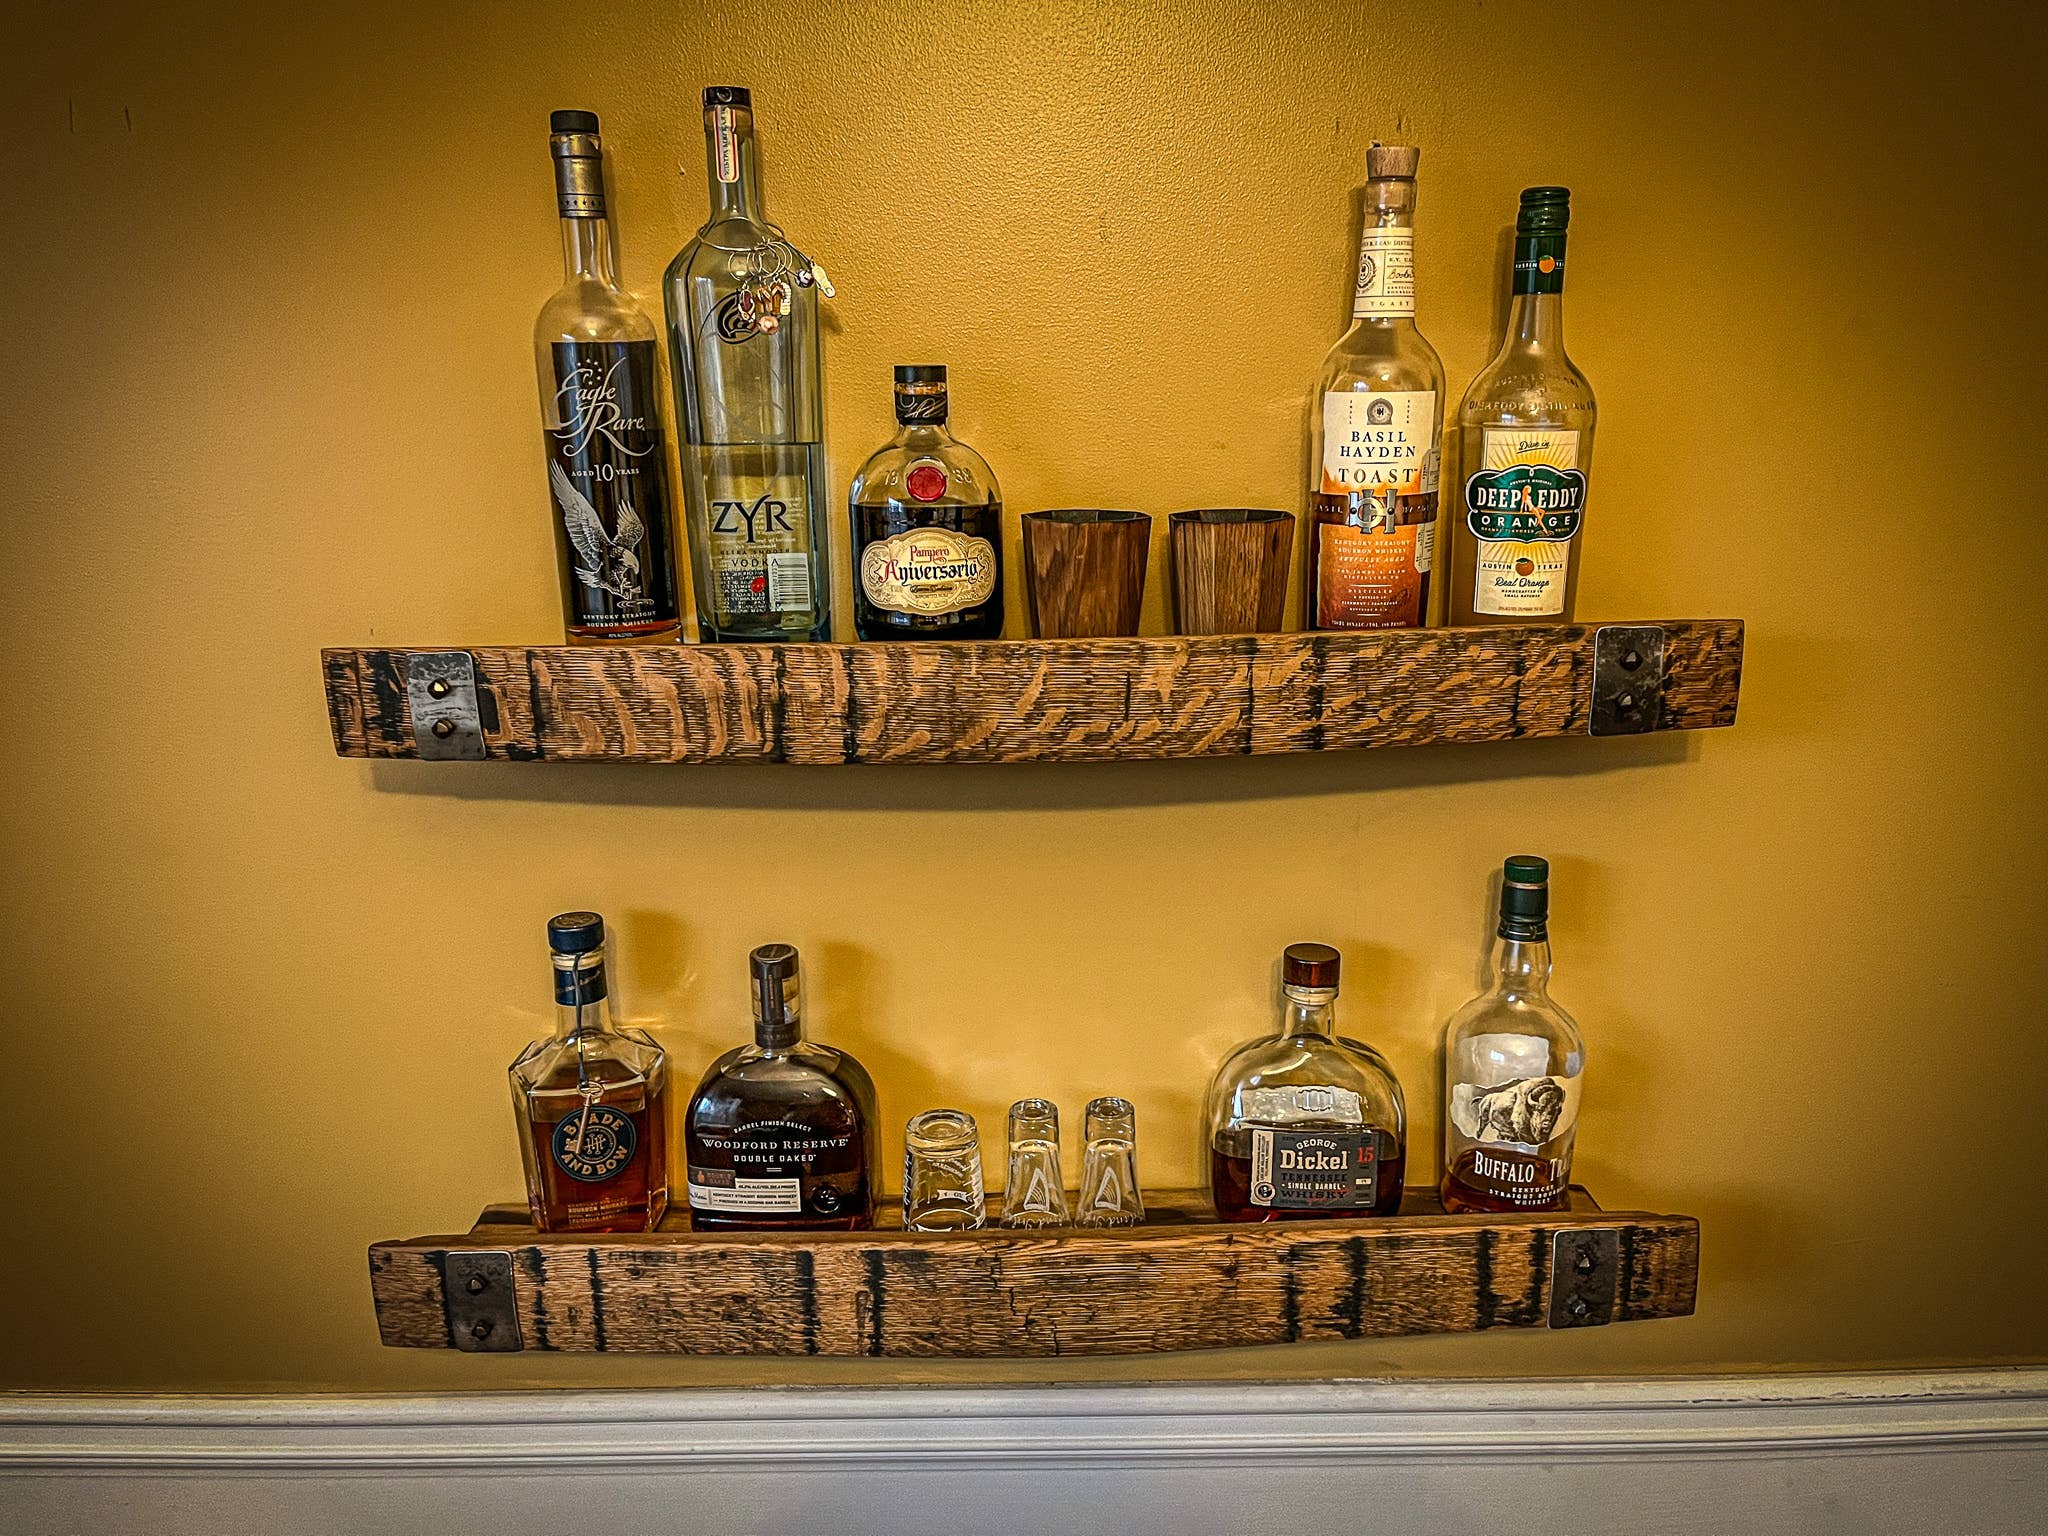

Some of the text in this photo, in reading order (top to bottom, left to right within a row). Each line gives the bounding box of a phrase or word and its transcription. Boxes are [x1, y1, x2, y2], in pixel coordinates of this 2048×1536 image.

[551, 357, 627, 438] Eagle
[563, 401, 654, 456] Rare
[1351, 430, 1407, 443] BASIL
[1340, 446, 1415, 458] HAYDEN
[594, 464, 614, 482] 10
[615, 468, 640, 476] YEARS
[1338, 468, 1414, 484] TOAST
[1476, 487, 1579, 508] DEEP EDDY
[712, 494, 795, 543] ZYR
[1481, 515, 1571, 527] ORANGE
[909, 544, 951, 562] Pampero
[731, 558, 779, 567] VODKA
[1482, 562, 1512, 570] AUSTIN
[878, 558, 978, 586] Aniversario
[1494, 576, 1550, 589] Real Orange
[621, 610, 656, 619] STRAIGHT
[622, 619, 654, 627] WHISKEY
[733, 1121, 759, 1134] BARREL
[786, 1121, 812, 1133] SELECT
[702, 1138, 847, 1149] WOODFORD RESERVE
[1296, 1138, 1338, 1150] GEORGE
[561, 1145, 628, 1175] AND BOW
[733, 1154, 814, 1163] DOUBLE OAKED
[1280, 1146, 1375, 1170] Dickel 15
[1474, 1150, 1534, 1184] BUFFALO
[1280, 1172, 1348, 1182] TENNESSEE
[1280, 1190, 1347, 1199] WHISKY
[1489, 1189, 1533, 1199] STRAIGHT
[1512, 1184, 1554, 1193] KENTUCKY
[1514, 1197, 1550, 1206] WHISKEY
